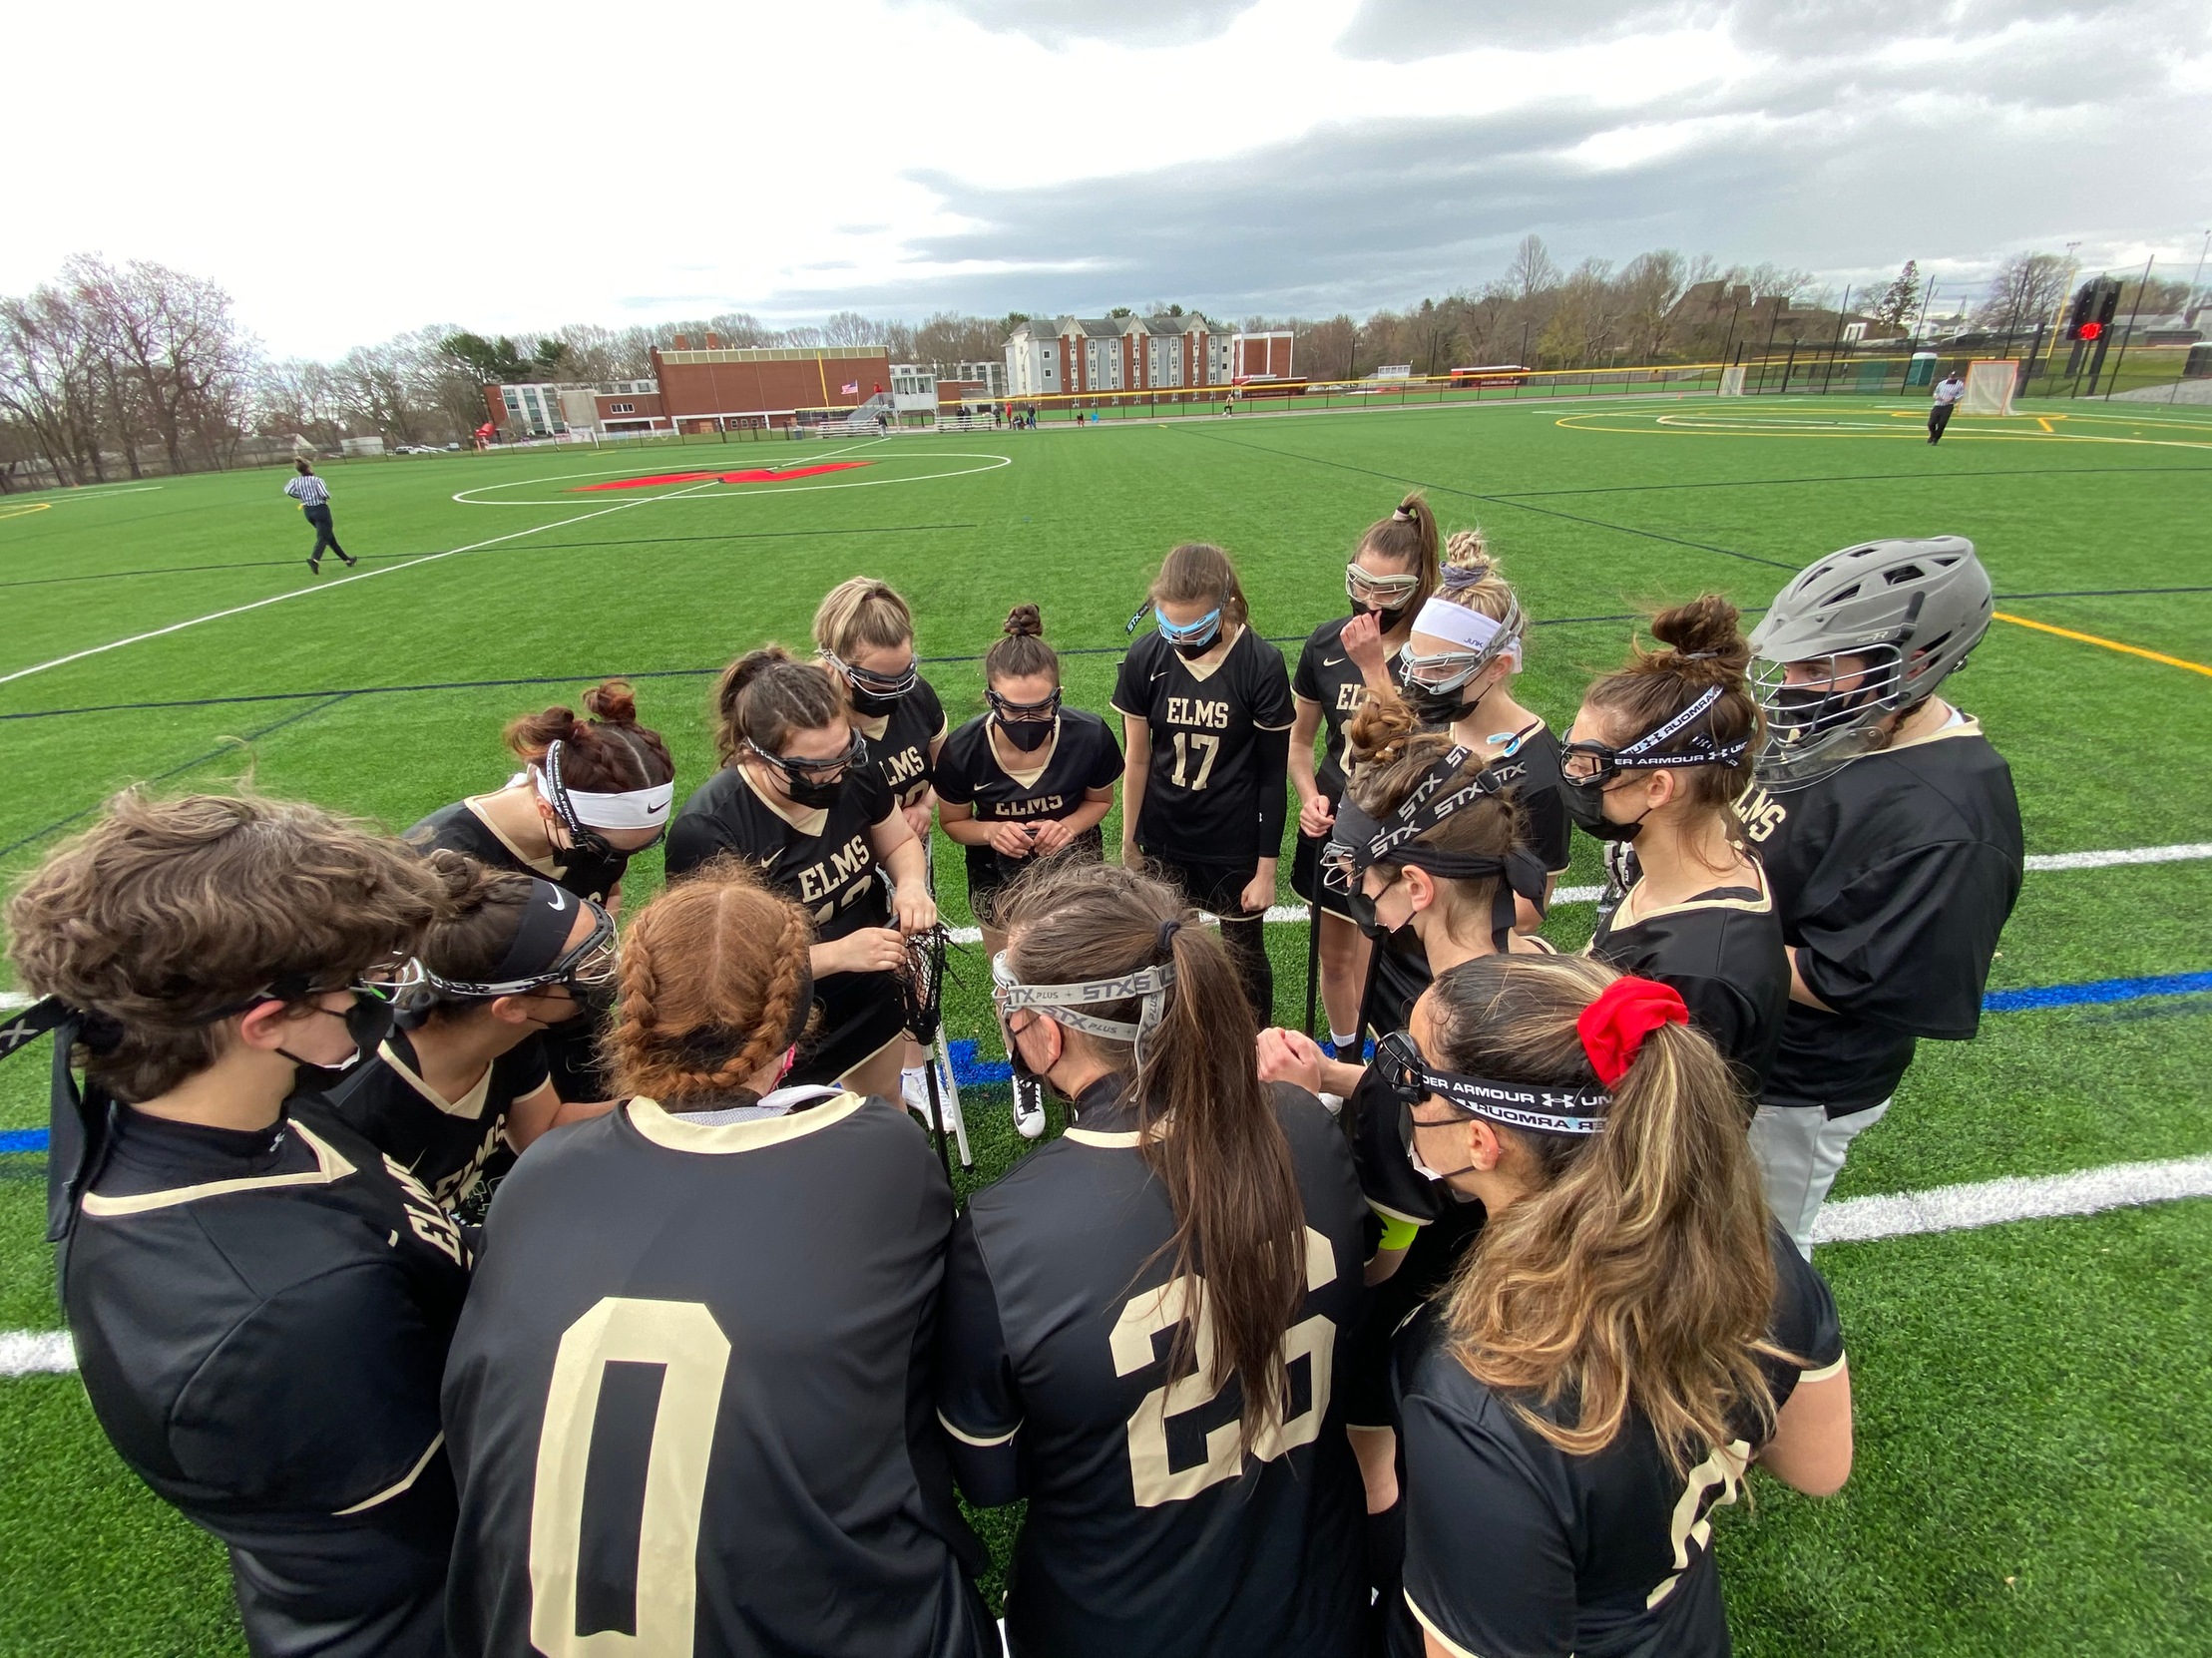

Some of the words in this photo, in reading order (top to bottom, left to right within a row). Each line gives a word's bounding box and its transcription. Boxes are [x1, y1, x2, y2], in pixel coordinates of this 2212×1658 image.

[1127, 613, 1141, 631] STX
[1464, 638, 1484, 648] JUNK
[1166, 697, 1229, 729] ELMS
[878, 746, 925, 786] LMS
[1171, 732, 1219, 790] 17
[1636, 755, 1704, 765] ARMOUR
[559, 792, 579, 832] ARMOU
[1398, 772, 1443, 822] STX
[1370, 819, 1422, 858] STX
[1434, 781, 1484, 819] STX
[798, 834, 870, 903] ELMS
[1012, 988, 1036, 1004] TX
[1036, 991, 1059, 1000] PLUS
[1088, 1022, 1117, 1035] PLUS
[1423, 1074, 1449, 1089] DER
[1452, 1082, 1536, 1104] ARMOUR
[1580, 1095, 1613, 1106] UN
[529, 1296, 732, 1658] 0
